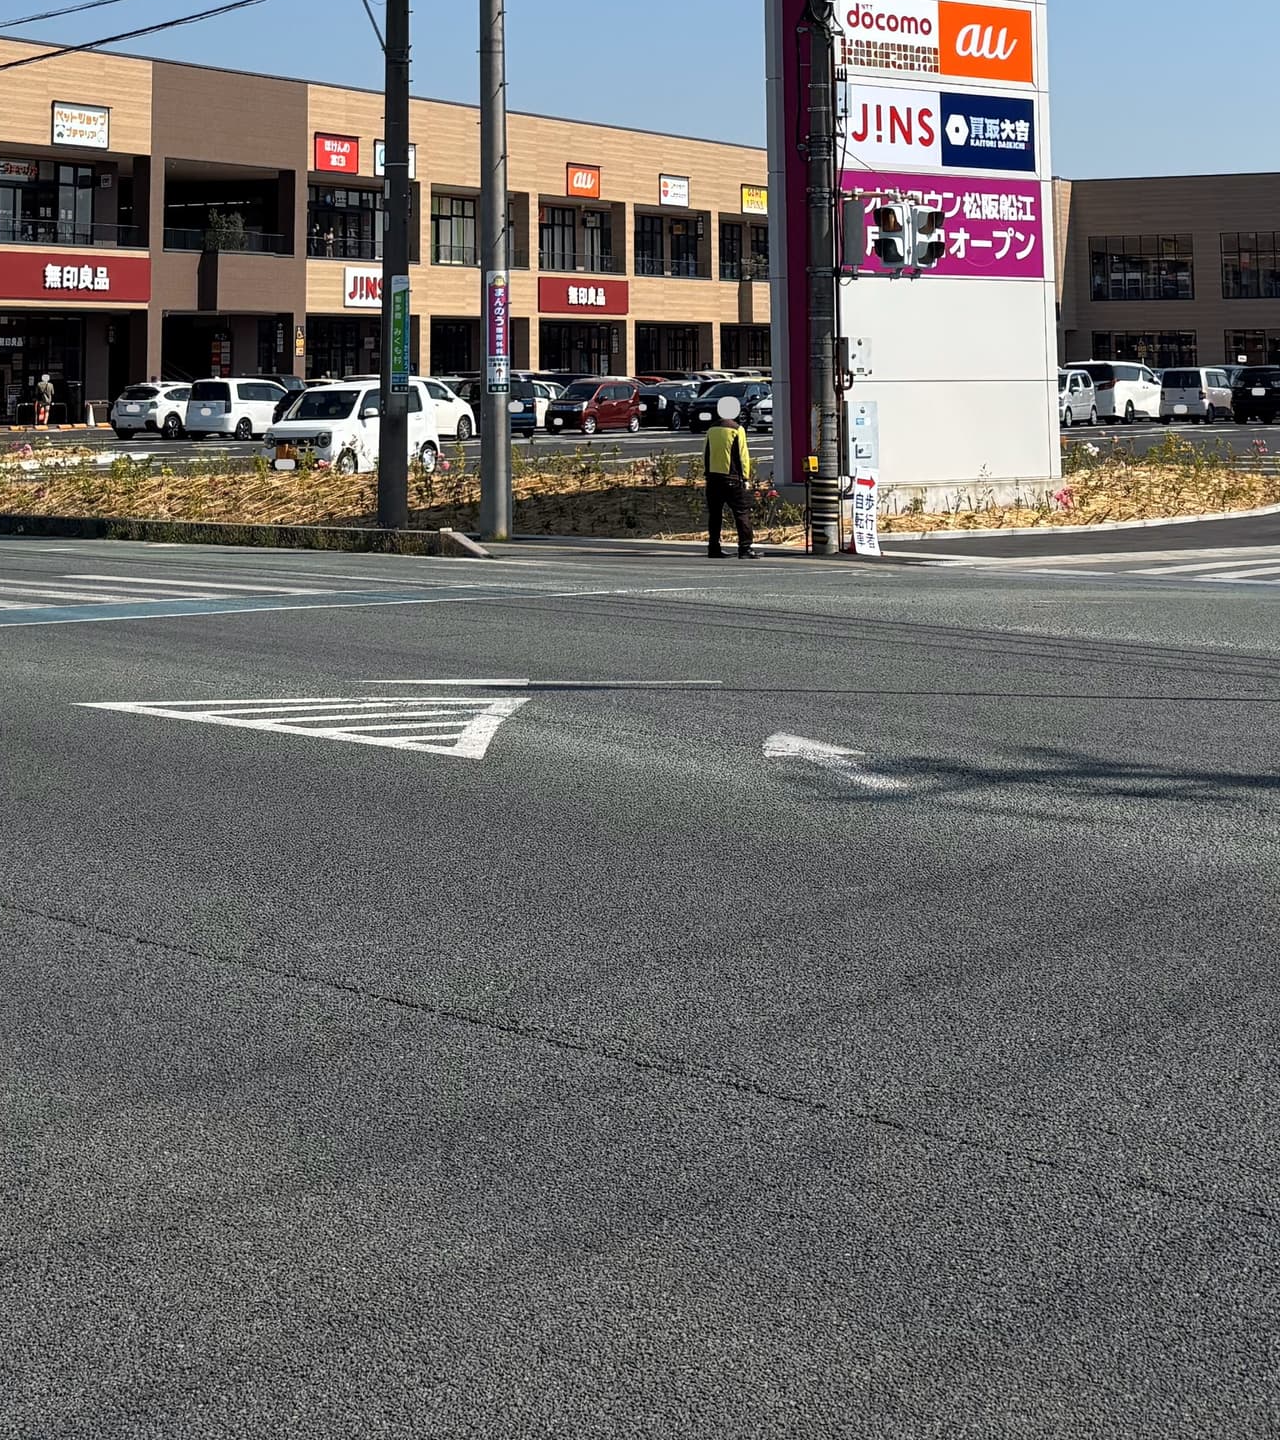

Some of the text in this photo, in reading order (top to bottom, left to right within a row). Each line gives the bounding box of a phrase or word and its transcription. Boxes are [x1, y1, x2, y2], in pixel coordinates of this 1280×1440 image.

[846, 3, 932, 36] docomo
[955, 23, 1018, 61] au
[969, 116, 1030, 142] 買取大吉
[573, 171, 595, 190] au
[44, 263, 110, 291] 無印良品
[567, 286, 606, 307] 無印良品
